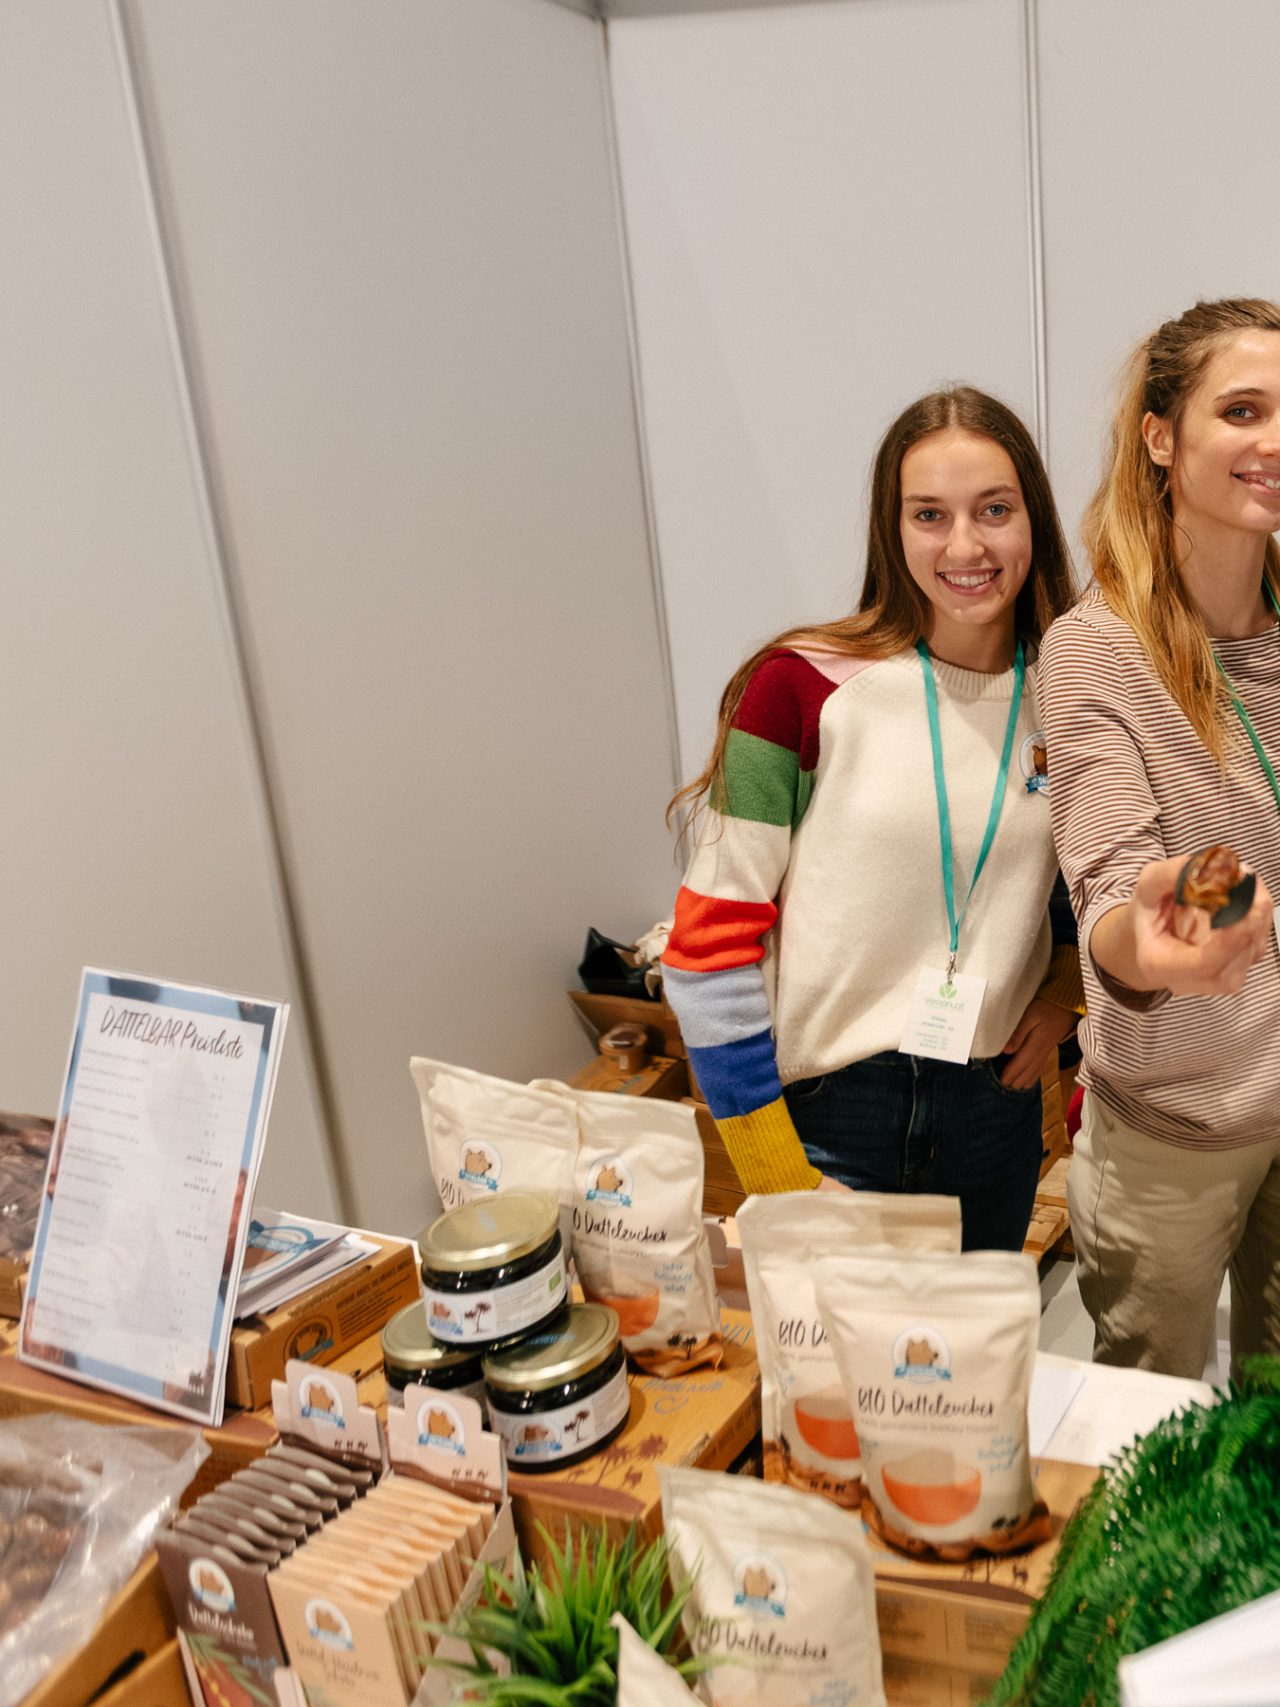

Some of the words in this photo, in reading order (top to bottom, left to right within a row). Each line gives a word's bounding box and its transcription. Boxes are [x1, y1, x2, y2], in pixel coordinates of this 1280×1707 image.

[585, 1210, 668, 1242] Dattelzucker
[778, 1319, 806, 1349] BIO
[857, 1387, 886, 1416] BIO
[892, 1388, 995, 1419] Dattelzucker
